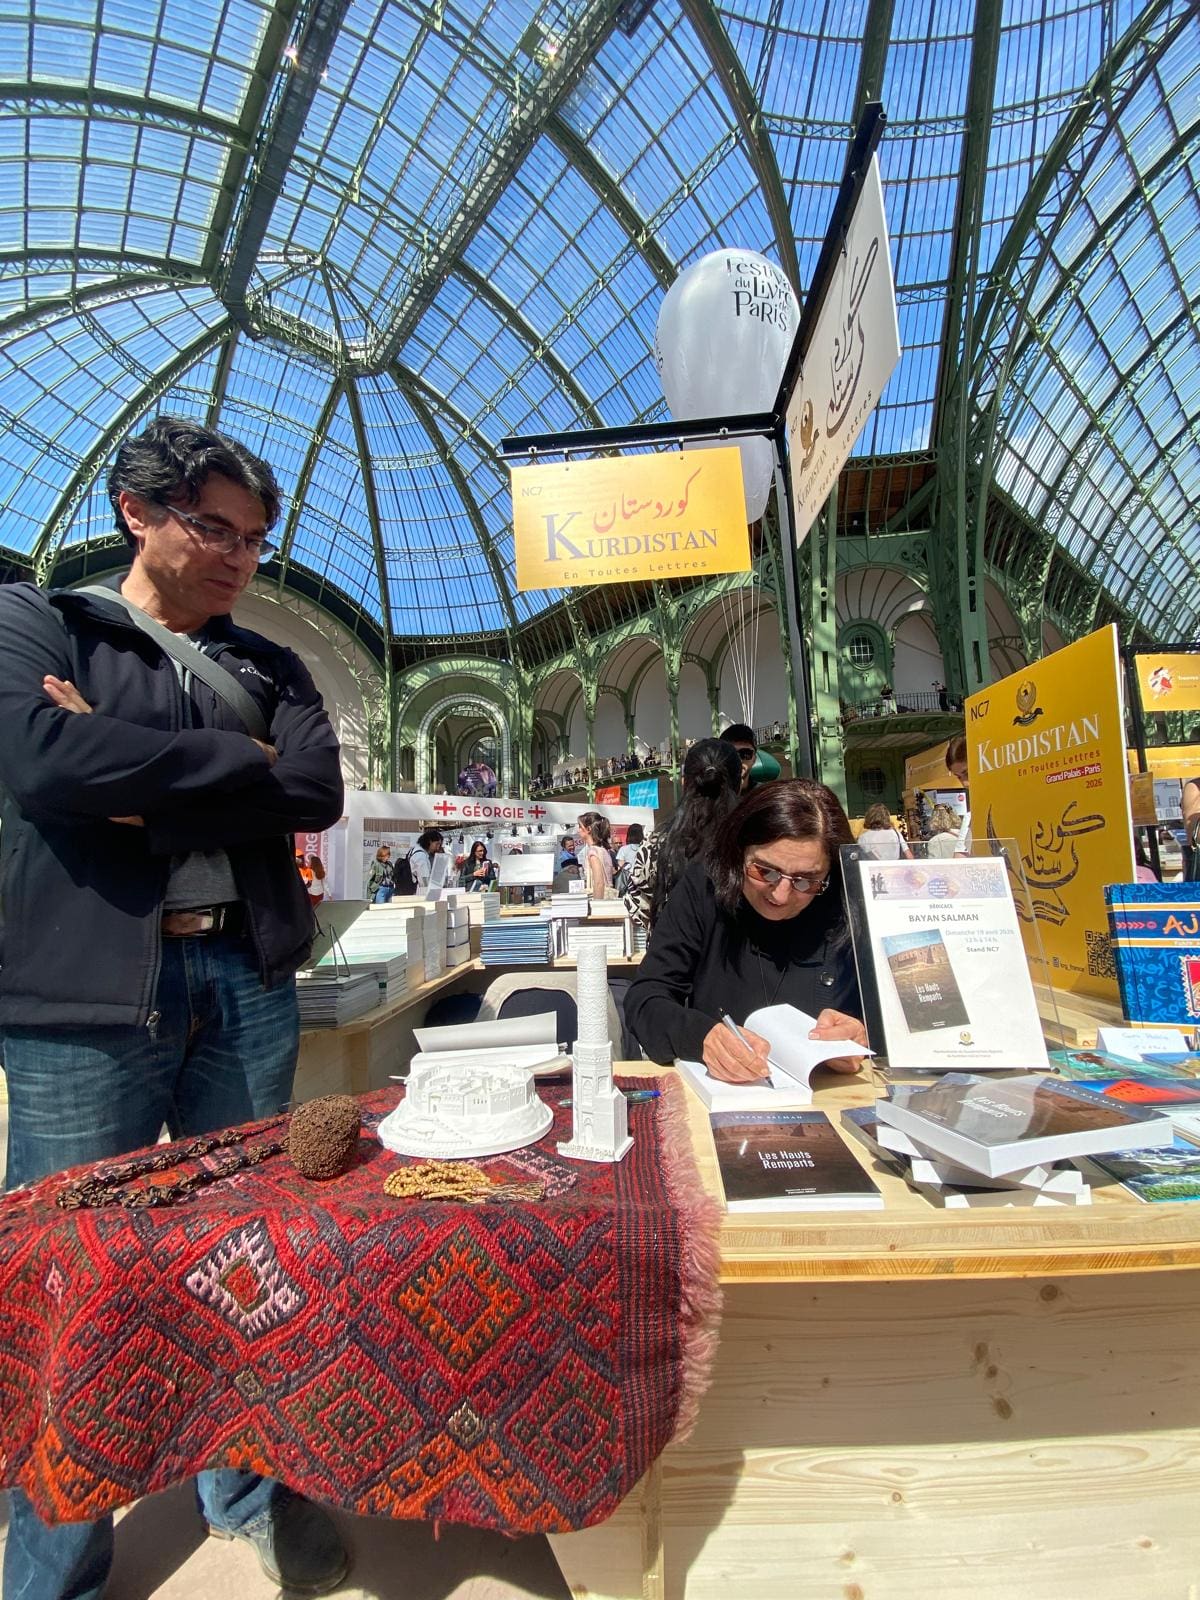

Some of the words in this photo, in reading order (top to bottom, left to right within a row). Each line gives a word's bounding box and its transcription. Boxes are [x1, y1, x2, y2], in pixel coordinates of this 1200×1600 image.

[735, 277, 750, 288] du
[753, 276, 792, 307] Livre
[521, 486, 543, 497] NC7
[541, 511, 718, 562] KURDISTAN
[564, 571, 579, 579] En
[590, 565, 638, 577] Toutes
[649, 560, 708, 572] Lettres
[970, 700, 990, 721] NC7
[976, 713, 1100, 774] KURDISTAN
[1017, 768, 1028, 777] En
[1030, 760, 1060, 774] Toutes
[1063, 750, 1101, 766] Lettres
[1046, 771, 1064, 784] Grand
[1064, 767, 1082, 780] Palais
[1085, 764, 1101, 776] Paris
[462, 802, 524, 819] GÉORGIE
[908, 914, 940, 923] BAYAN
[941, 913, 979, 922] SALMAN
[758, 1151, 778, 1160] Les
[779, 1150, 812, 1160] Hauts
[763, 1158, 816, 1169] Remparts
